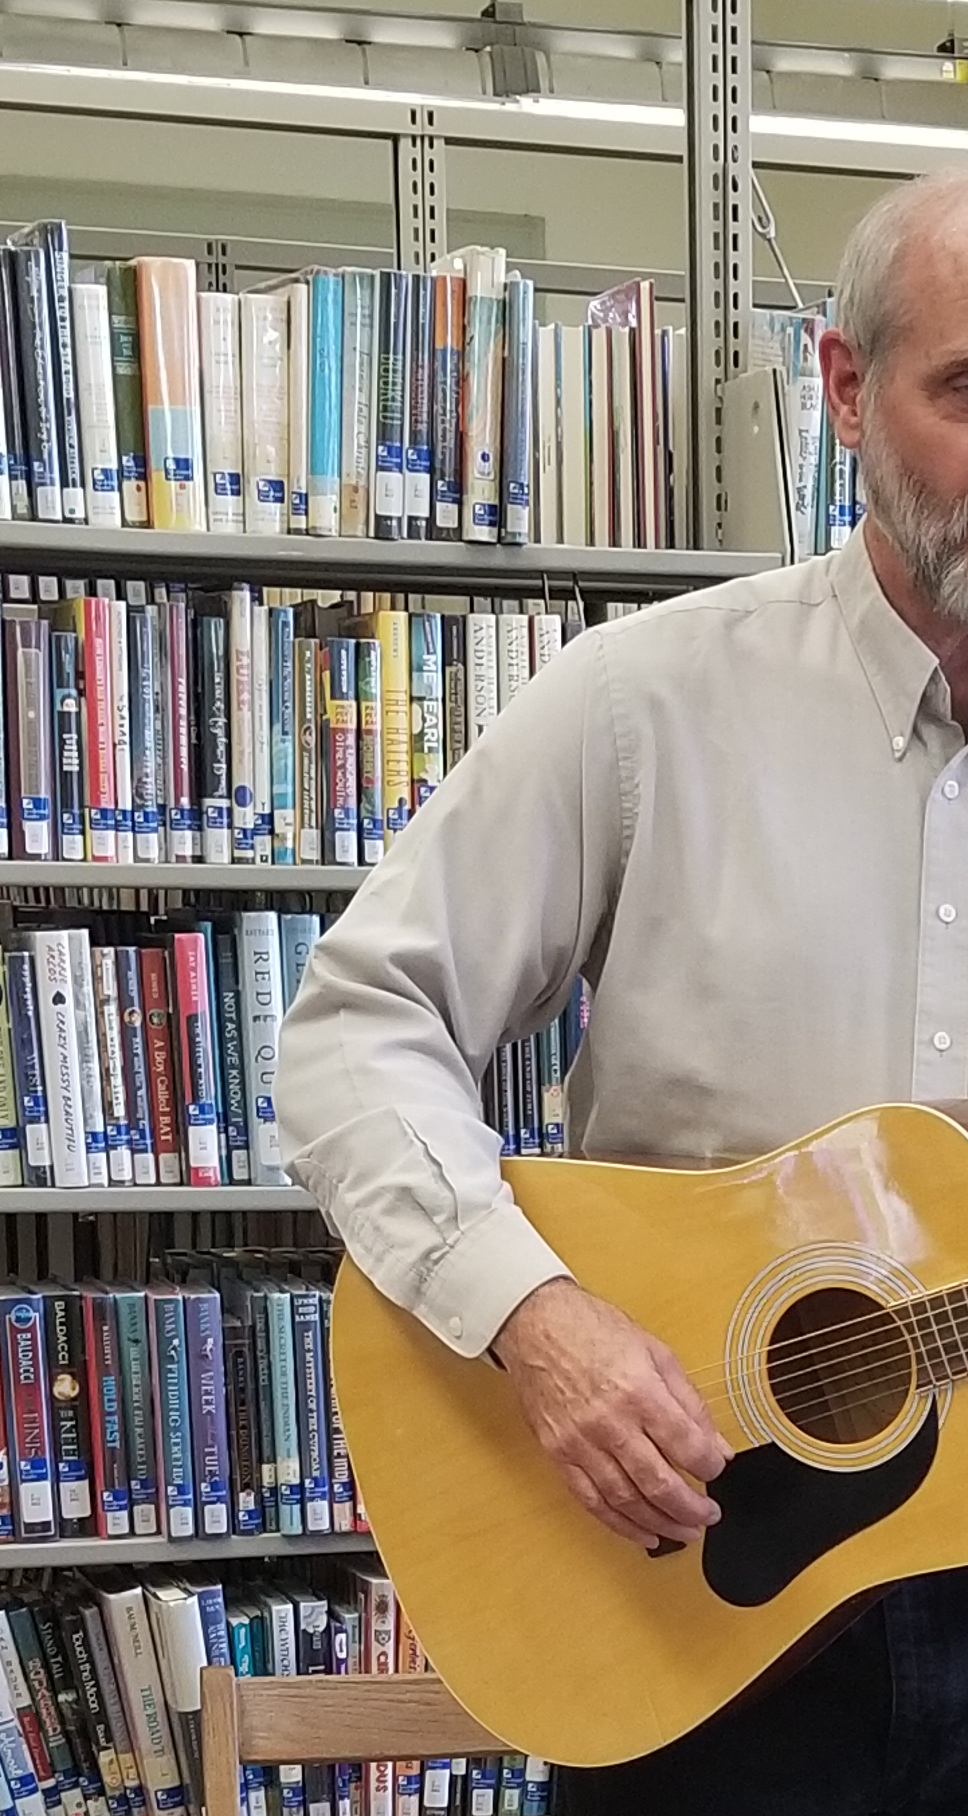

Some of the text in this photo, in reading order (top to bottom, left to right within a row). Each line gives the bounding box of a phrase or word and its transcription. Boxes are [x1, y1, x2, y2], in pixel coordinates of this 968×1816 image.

[474, 622, 487, 718] ANDERSON
[422, 654, 438, 753] ME EARL
[385, 689, 409, 788] THE HATERS
[253, 950, 273, 1007] RED
[222, 991, 243, 1113] NOT AS WE KNOW
[56, 1011, 76, 1153] CRAZY MESSY BEAUTIFU
[153, 1039, 173, 1142] A Boy Called BAT
[16, 1333, 35, 1385] BALDACCI
[53, 1301, 69, 1365] BALDACCI
[302, 1330, 315, 1350] THE
[102, 1375, 118, 1411] HOLD
[200, 1371, 216, 1414] WEEK
[303, 1352, 316, 1396] MYSTERY
[305, 1397, 315, 1410] OF
[306, 1412, 318, 1430] THE
[105, 1416, 120, 1450] FAST
[332, 1434, 346, 1456] THE
[41, 1622, 58, 1656] STAND
[49, 1656, 63, 1679] TALL
[71, 1630, 101, 1713] Touch the Moon
[139, 1685, 164, 1744] THE ROAD
